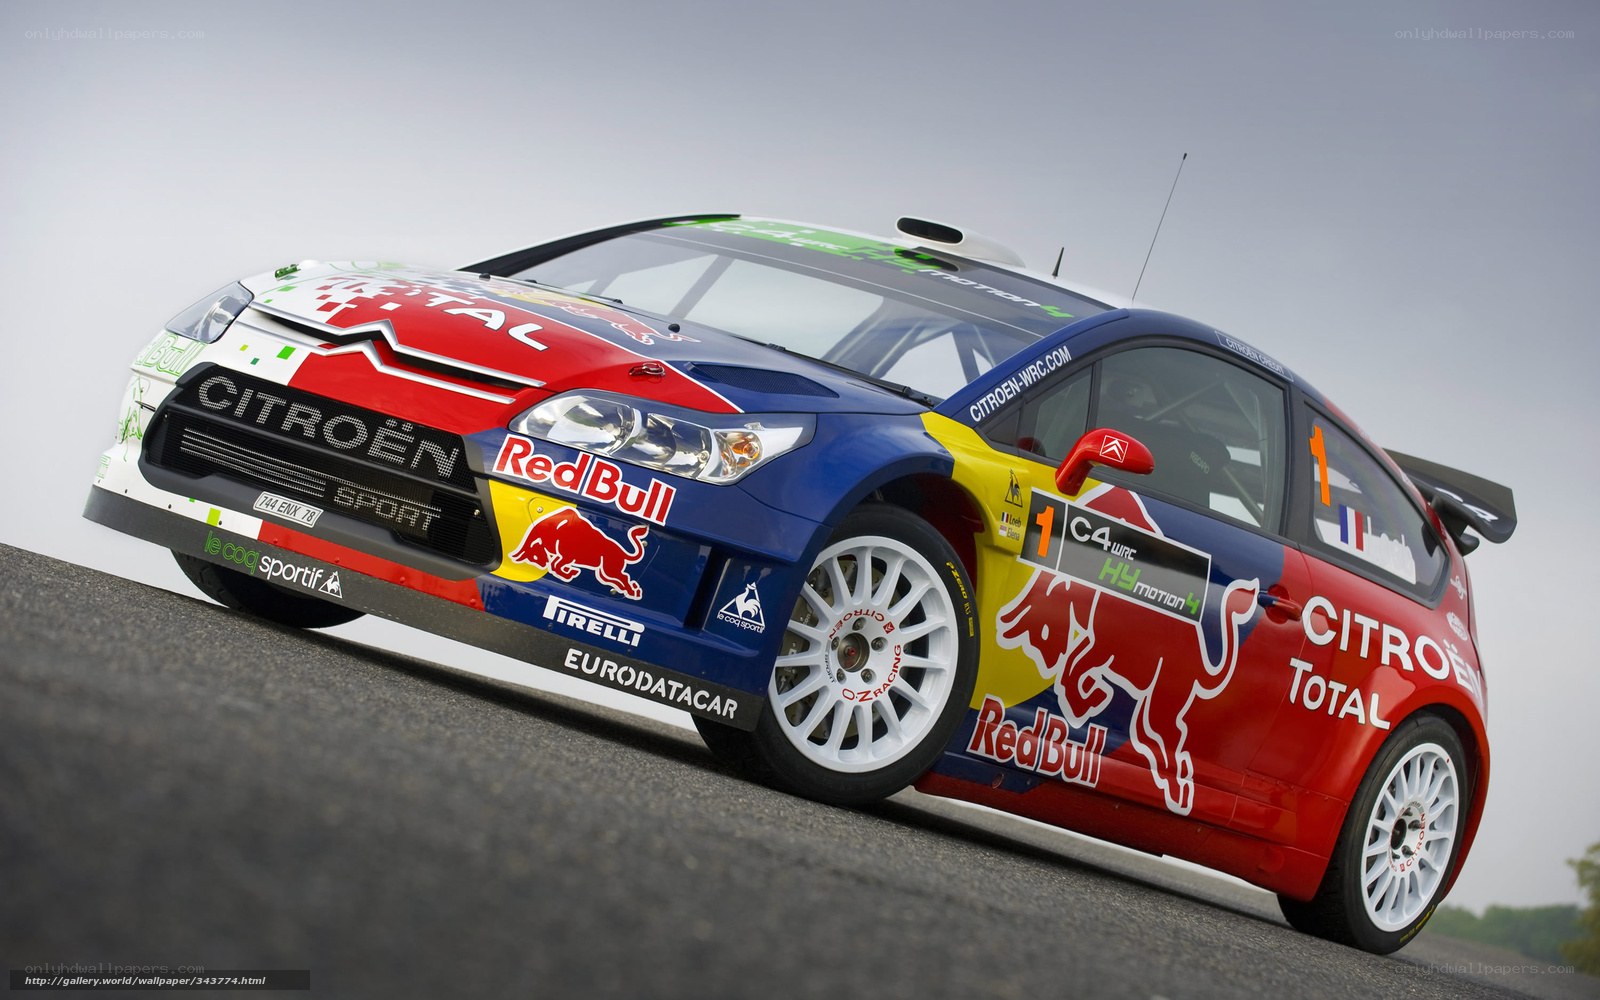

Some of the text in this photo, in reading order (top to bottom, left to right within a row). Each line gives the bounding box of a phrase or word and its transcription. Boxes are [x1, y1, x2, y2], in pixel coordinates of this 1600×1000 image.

[970, 345, 1073, 423] CITROEN-WRC.COM
[198, 376, 460, 479] CITROËN
[492, 433, 677, 527] Red Bull
[1310, 424, 1331, 507] 1
[258, 495, 317, 523] 744 ENX 78
[334, 486, 442, 531] SPORT
[1008, 513, 1022, 528] Loeb
[1035, 505, 1055, 558] 1
[204, 530, 323, 589] le coq sportif
[1070, 516, 1137, 561] C4 WRC
[543, 595, 646, 647] PIRELLI
[724, 616, 741, 628] coq
[873, 644, 901, 698] RACING
[1302, 596, 1484, 709] CITROËN
[564, 648, 739, 720] EURODATACAR
[1289, 657, 1391, 731] TOTAL
[967, 693, 1109, 788] Red Bull
